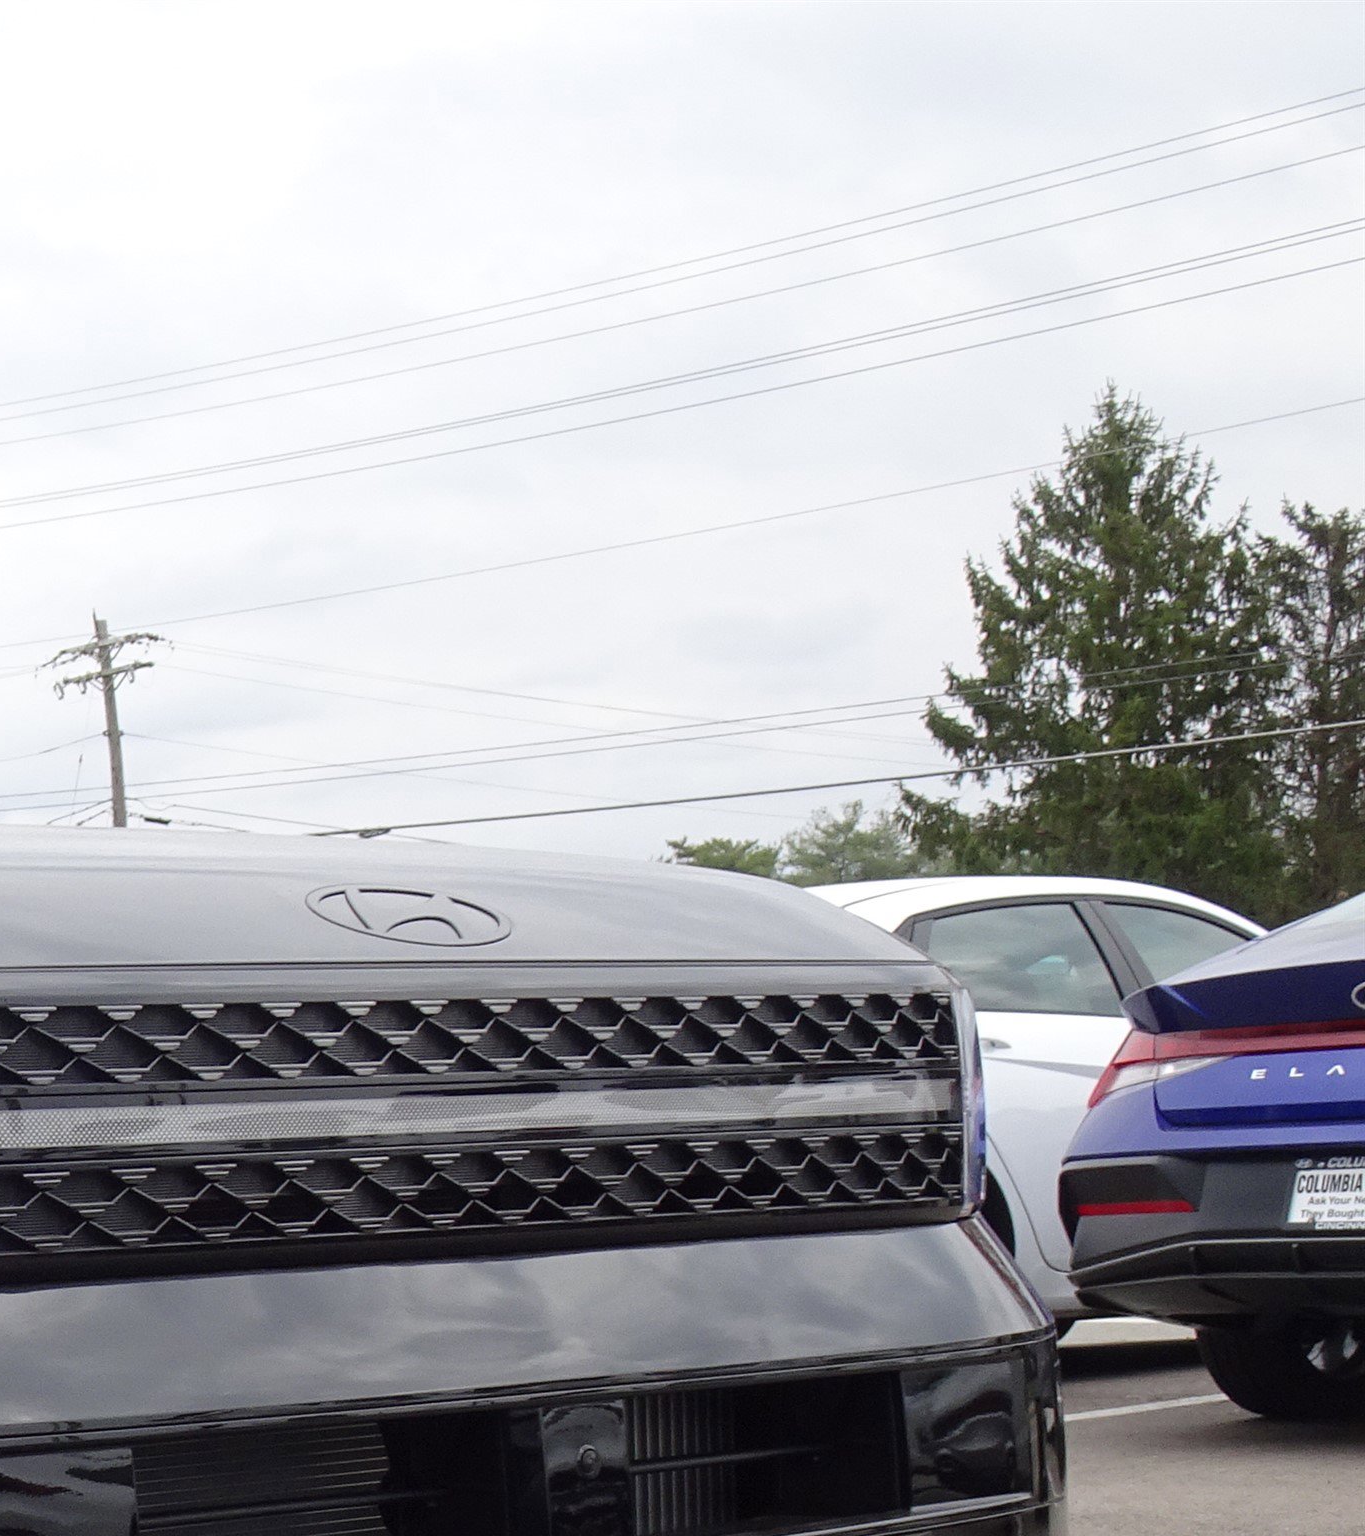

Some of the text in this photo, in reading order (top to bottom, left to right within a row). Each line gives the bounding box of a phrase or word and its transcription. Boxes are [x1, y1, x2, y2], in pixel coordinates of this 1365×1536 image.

[1297, 1174, 1363, 1193] COLUMBIA
[1308, 1196, 1326, 1205] Ask
[1329, 1196, 1352, 1205] Your
[1301, 1209, 1365, 1219] They Bought
